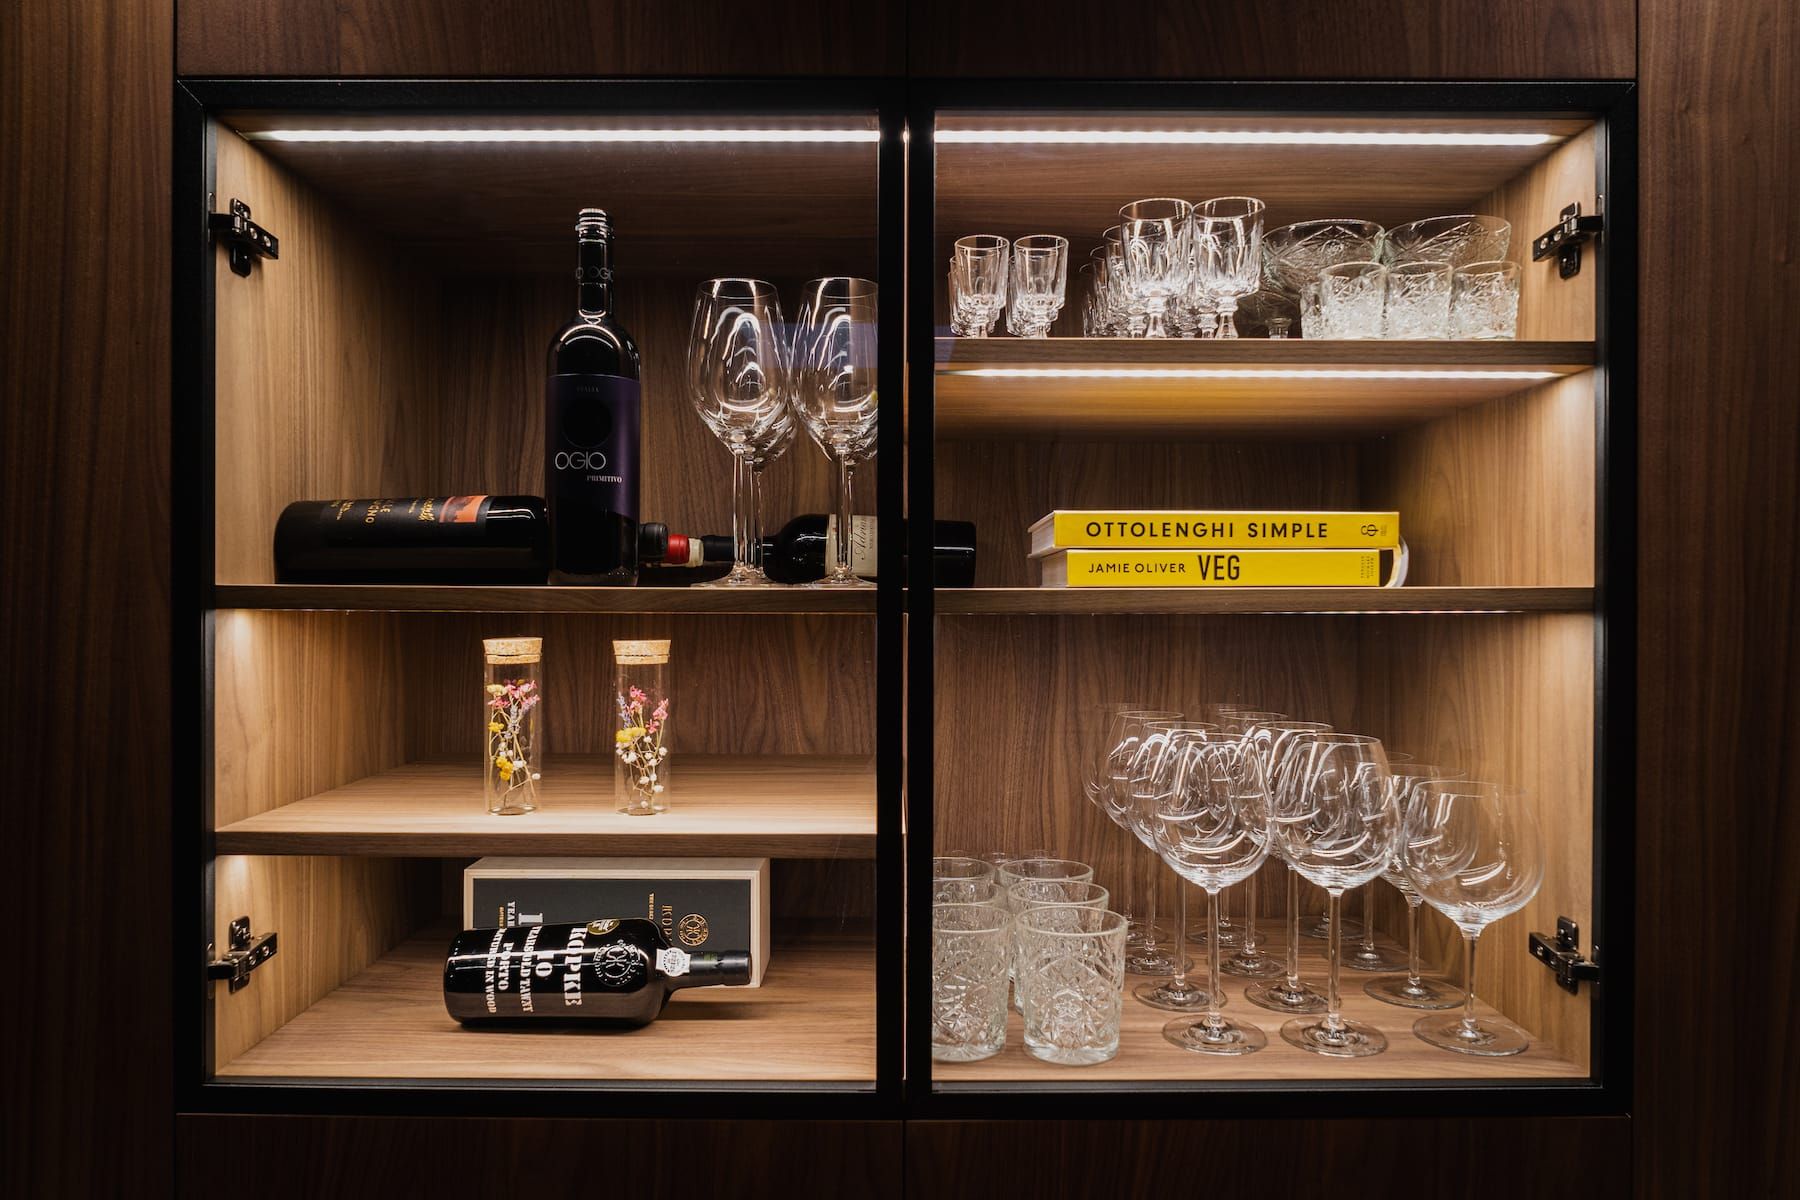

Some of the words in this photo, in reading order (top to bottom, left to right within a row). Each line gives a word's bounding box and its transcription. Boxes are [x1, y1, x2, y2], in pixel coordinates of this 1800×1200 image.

[555, 451, 607, 470] OGIO
[586, 474, 623, 484] PRIMITIVO
[1086, 521, 1233, 538] OTTOLENGHI
[1247, 522, 1328, 538] SIMPLE
[1088, 563, 1130, 573] JAMIE
[1134, 563, 1186, 573] OLIVER
[1198, 554, 1240, 581] VEG
[507, 901, 515, 927] YEAR
[661, 905, 673, 941] KOP
[485, 970, 495, 983] IN
[498, 942, 514, 991] PORTO
[520, 954, 532, 977] OLD
[535, 950, 555, 977] 10
[563, 927, 588, 1006] KOPKE
[485, 984, 497, 1013] WOOD
